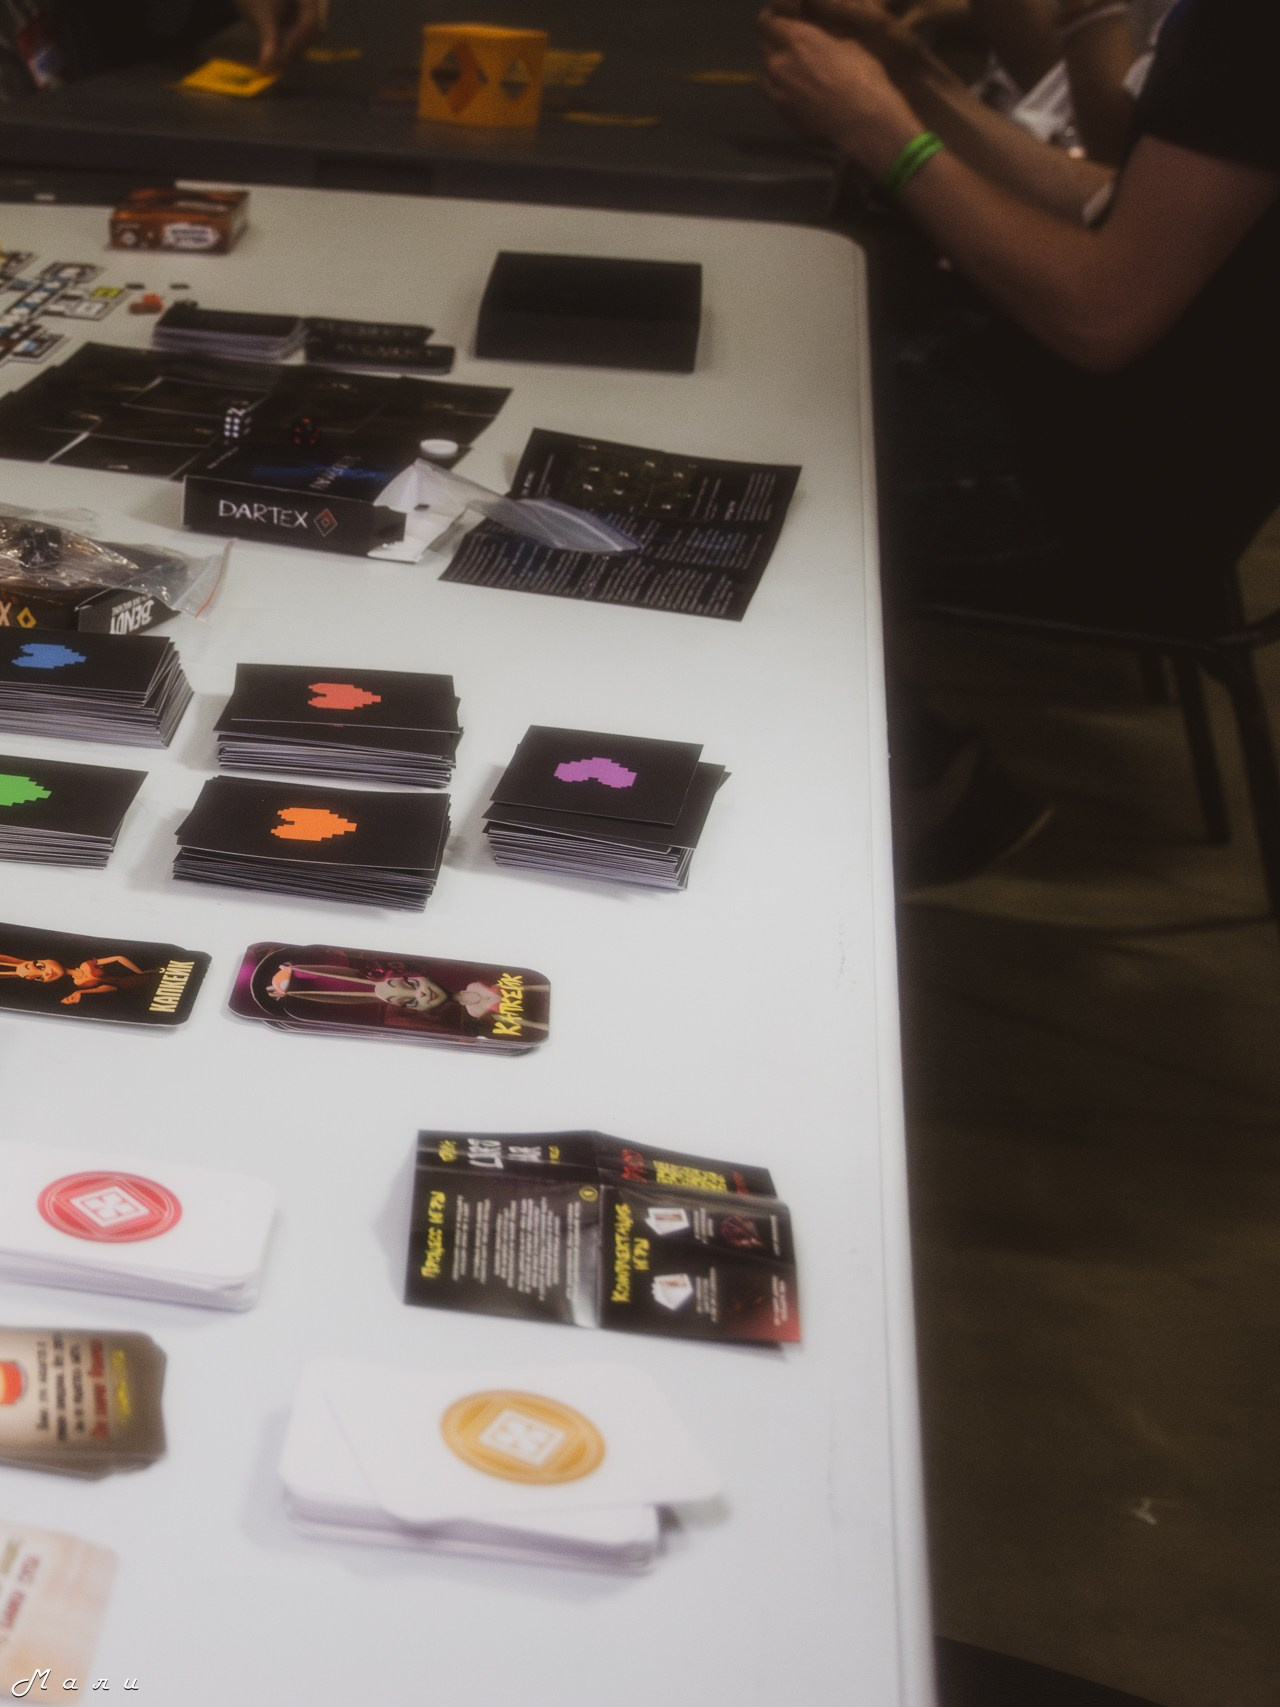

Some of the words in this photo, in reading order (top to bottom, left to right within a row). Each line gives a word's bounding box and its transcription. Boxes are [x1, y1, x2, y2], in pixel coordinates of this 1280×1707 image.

[218, 498, 309, 530] DARTEX
[148, 959, 196, 1013] КАПКЕЙК
[493, 972, 523, 1036] КАПКЕЙК
